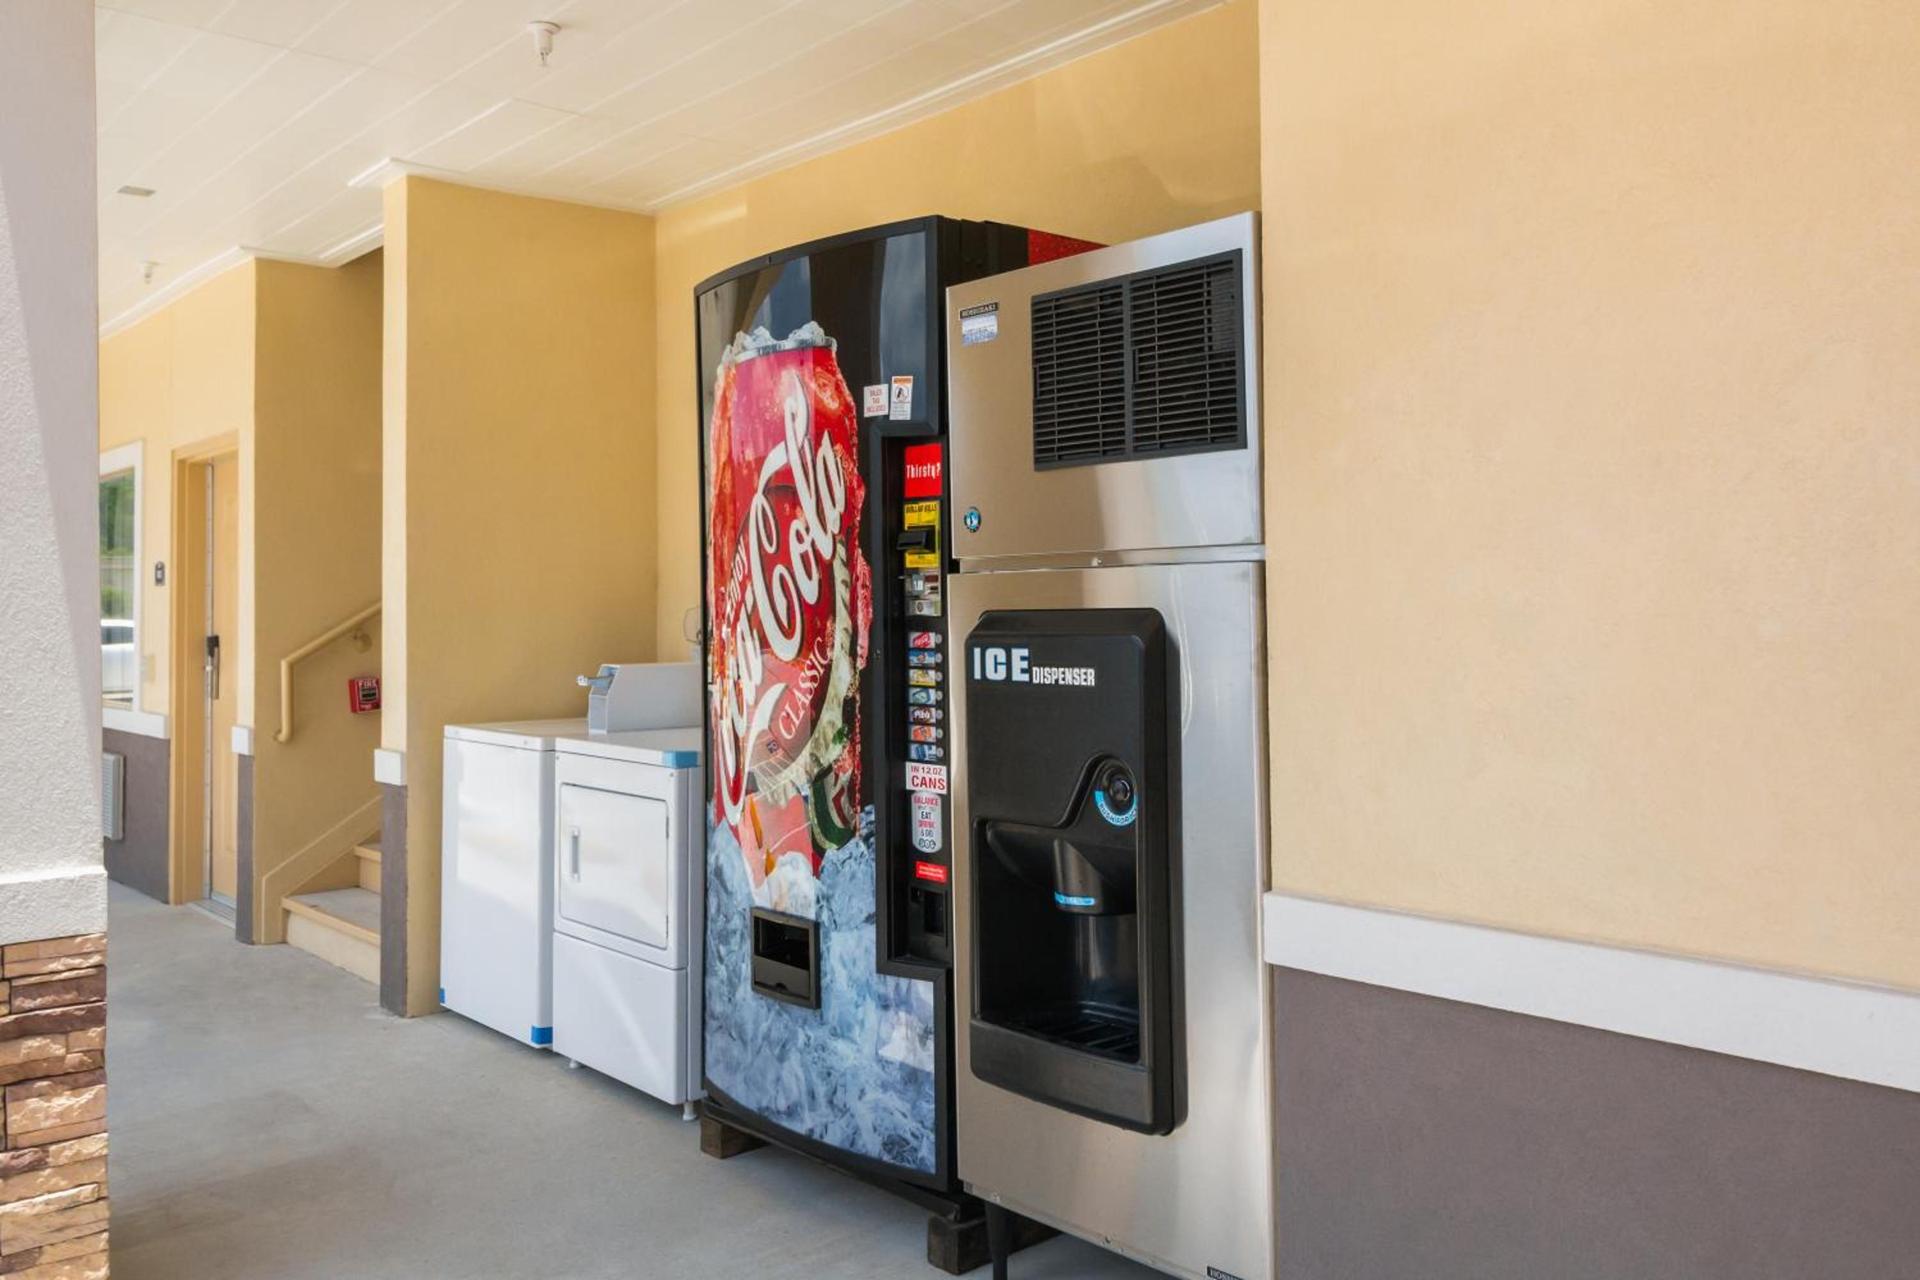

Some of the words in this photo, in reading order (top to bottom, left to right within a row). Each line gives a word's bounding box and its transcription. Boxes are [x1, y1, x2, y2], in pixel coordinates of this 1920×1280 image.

[906, 462, 941, 479] Thirsty?
[973, 647, 1030, 682] ICE
[1032, 666, 1096, 687] DISPENSER
[778, 636, 831, 741] CLASSIC
[911, 765, 919, 773] IN
[911, 775, 945, 790] CANS
[921, 811, 931, 819] EAT
